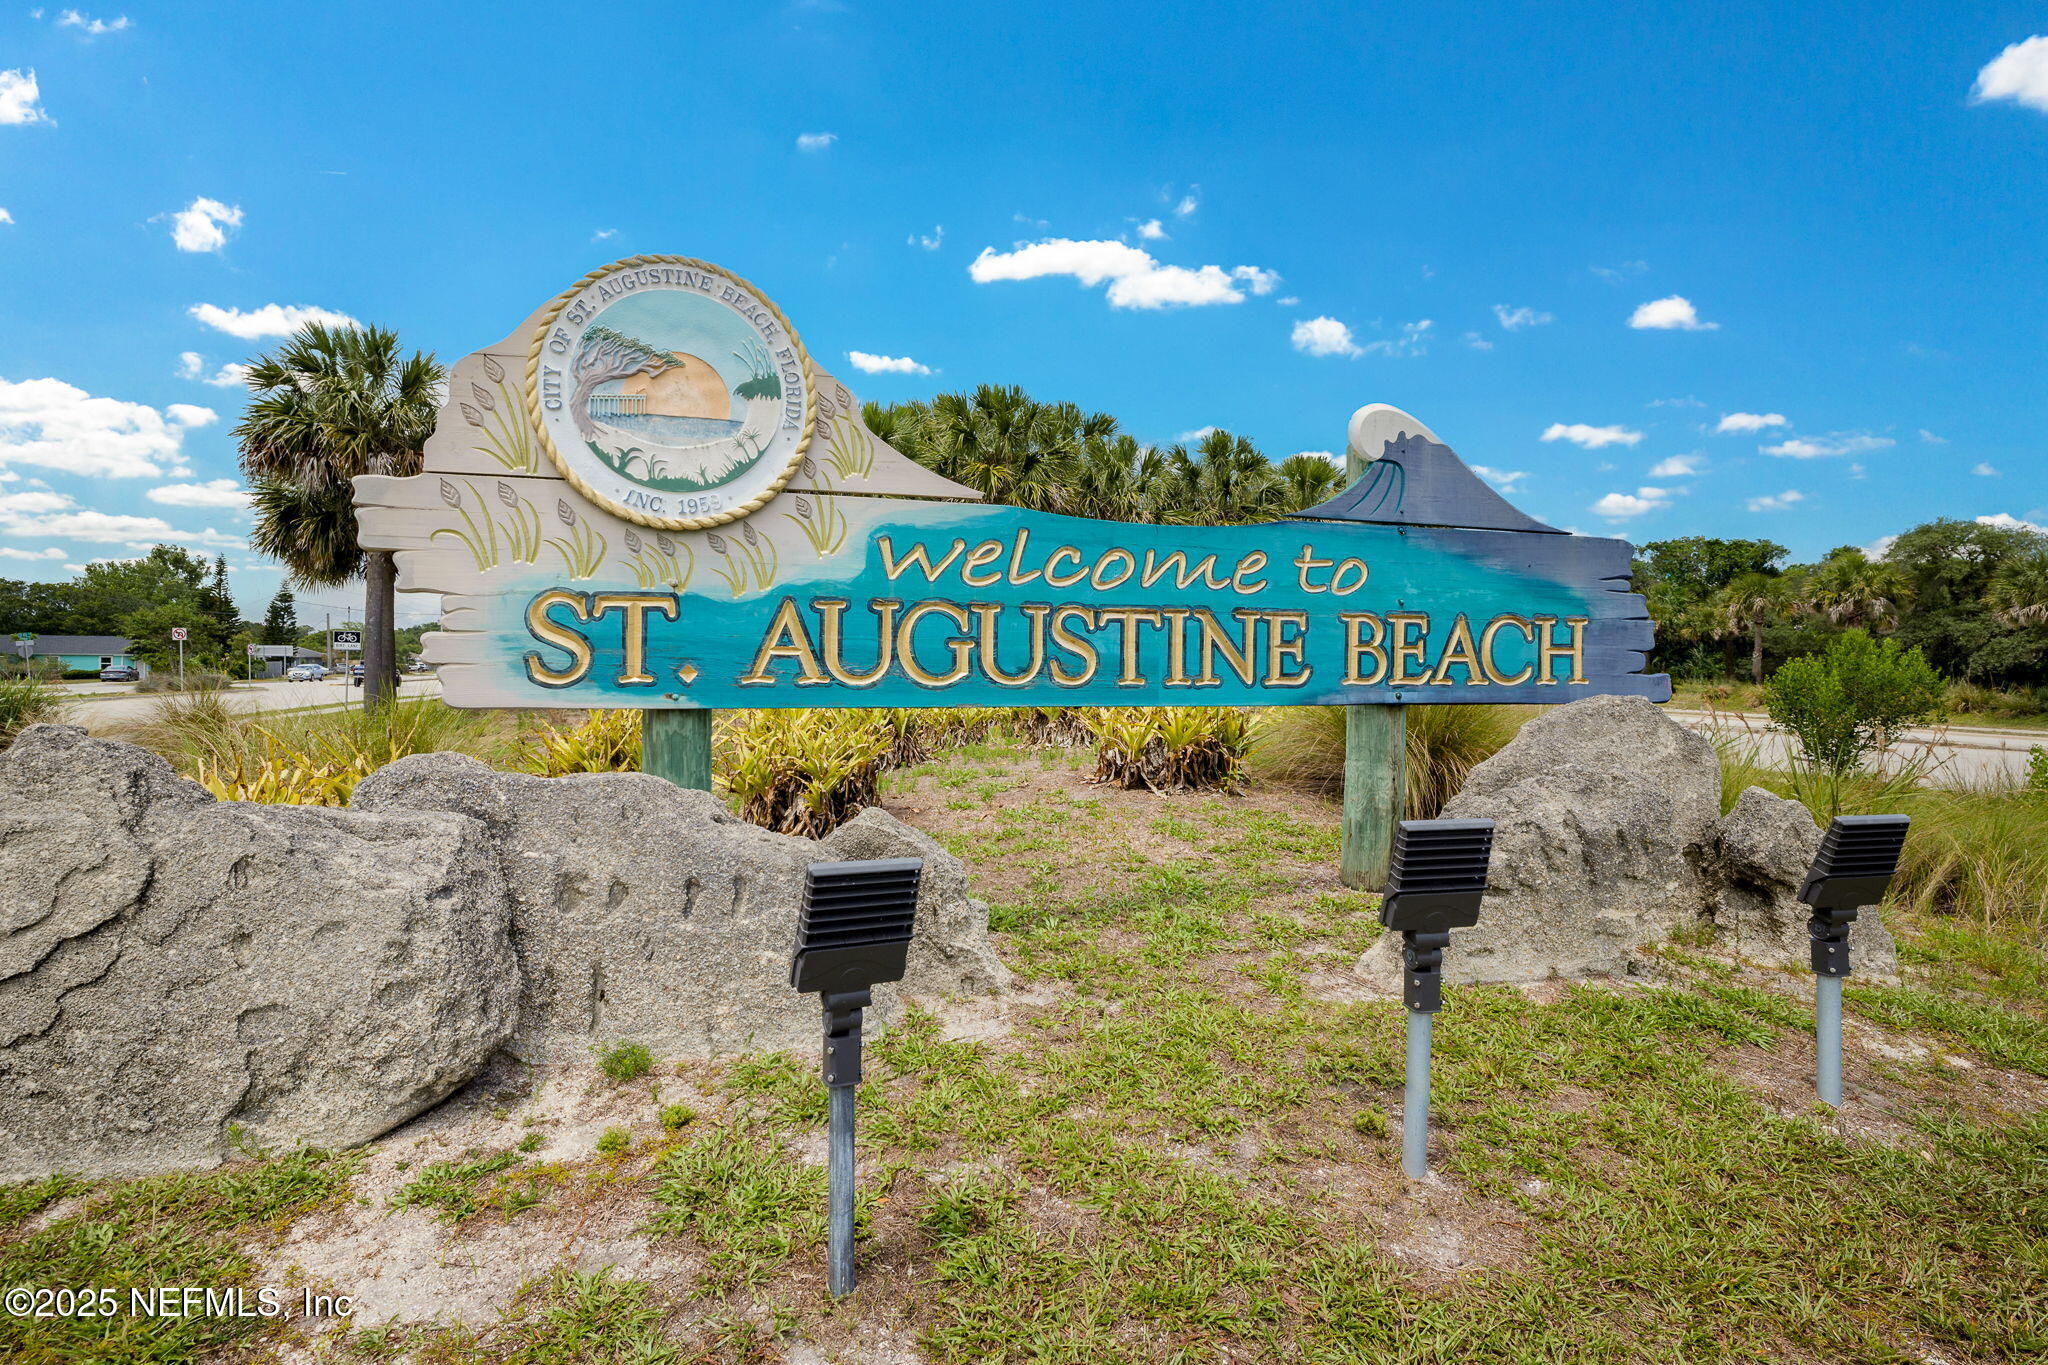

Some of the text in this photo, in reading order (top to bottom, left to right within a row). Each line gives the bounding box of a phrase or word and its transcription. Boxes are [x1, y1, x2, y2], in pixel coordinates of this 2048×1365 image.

[598, 269, 714, 302] AUGUSTINE
[566, 299, 597, 326] ST.
[549, 327, 572, 354] OF
[543, 365, 562, 411] CITY
[775, 346, 802, 430] FLORIDA
[623, 490, 666, 513] INC.
[1294, 543, 1370, 596] to
[524, 588, 1591, 690] ST. AUGUSTINE BEACH
